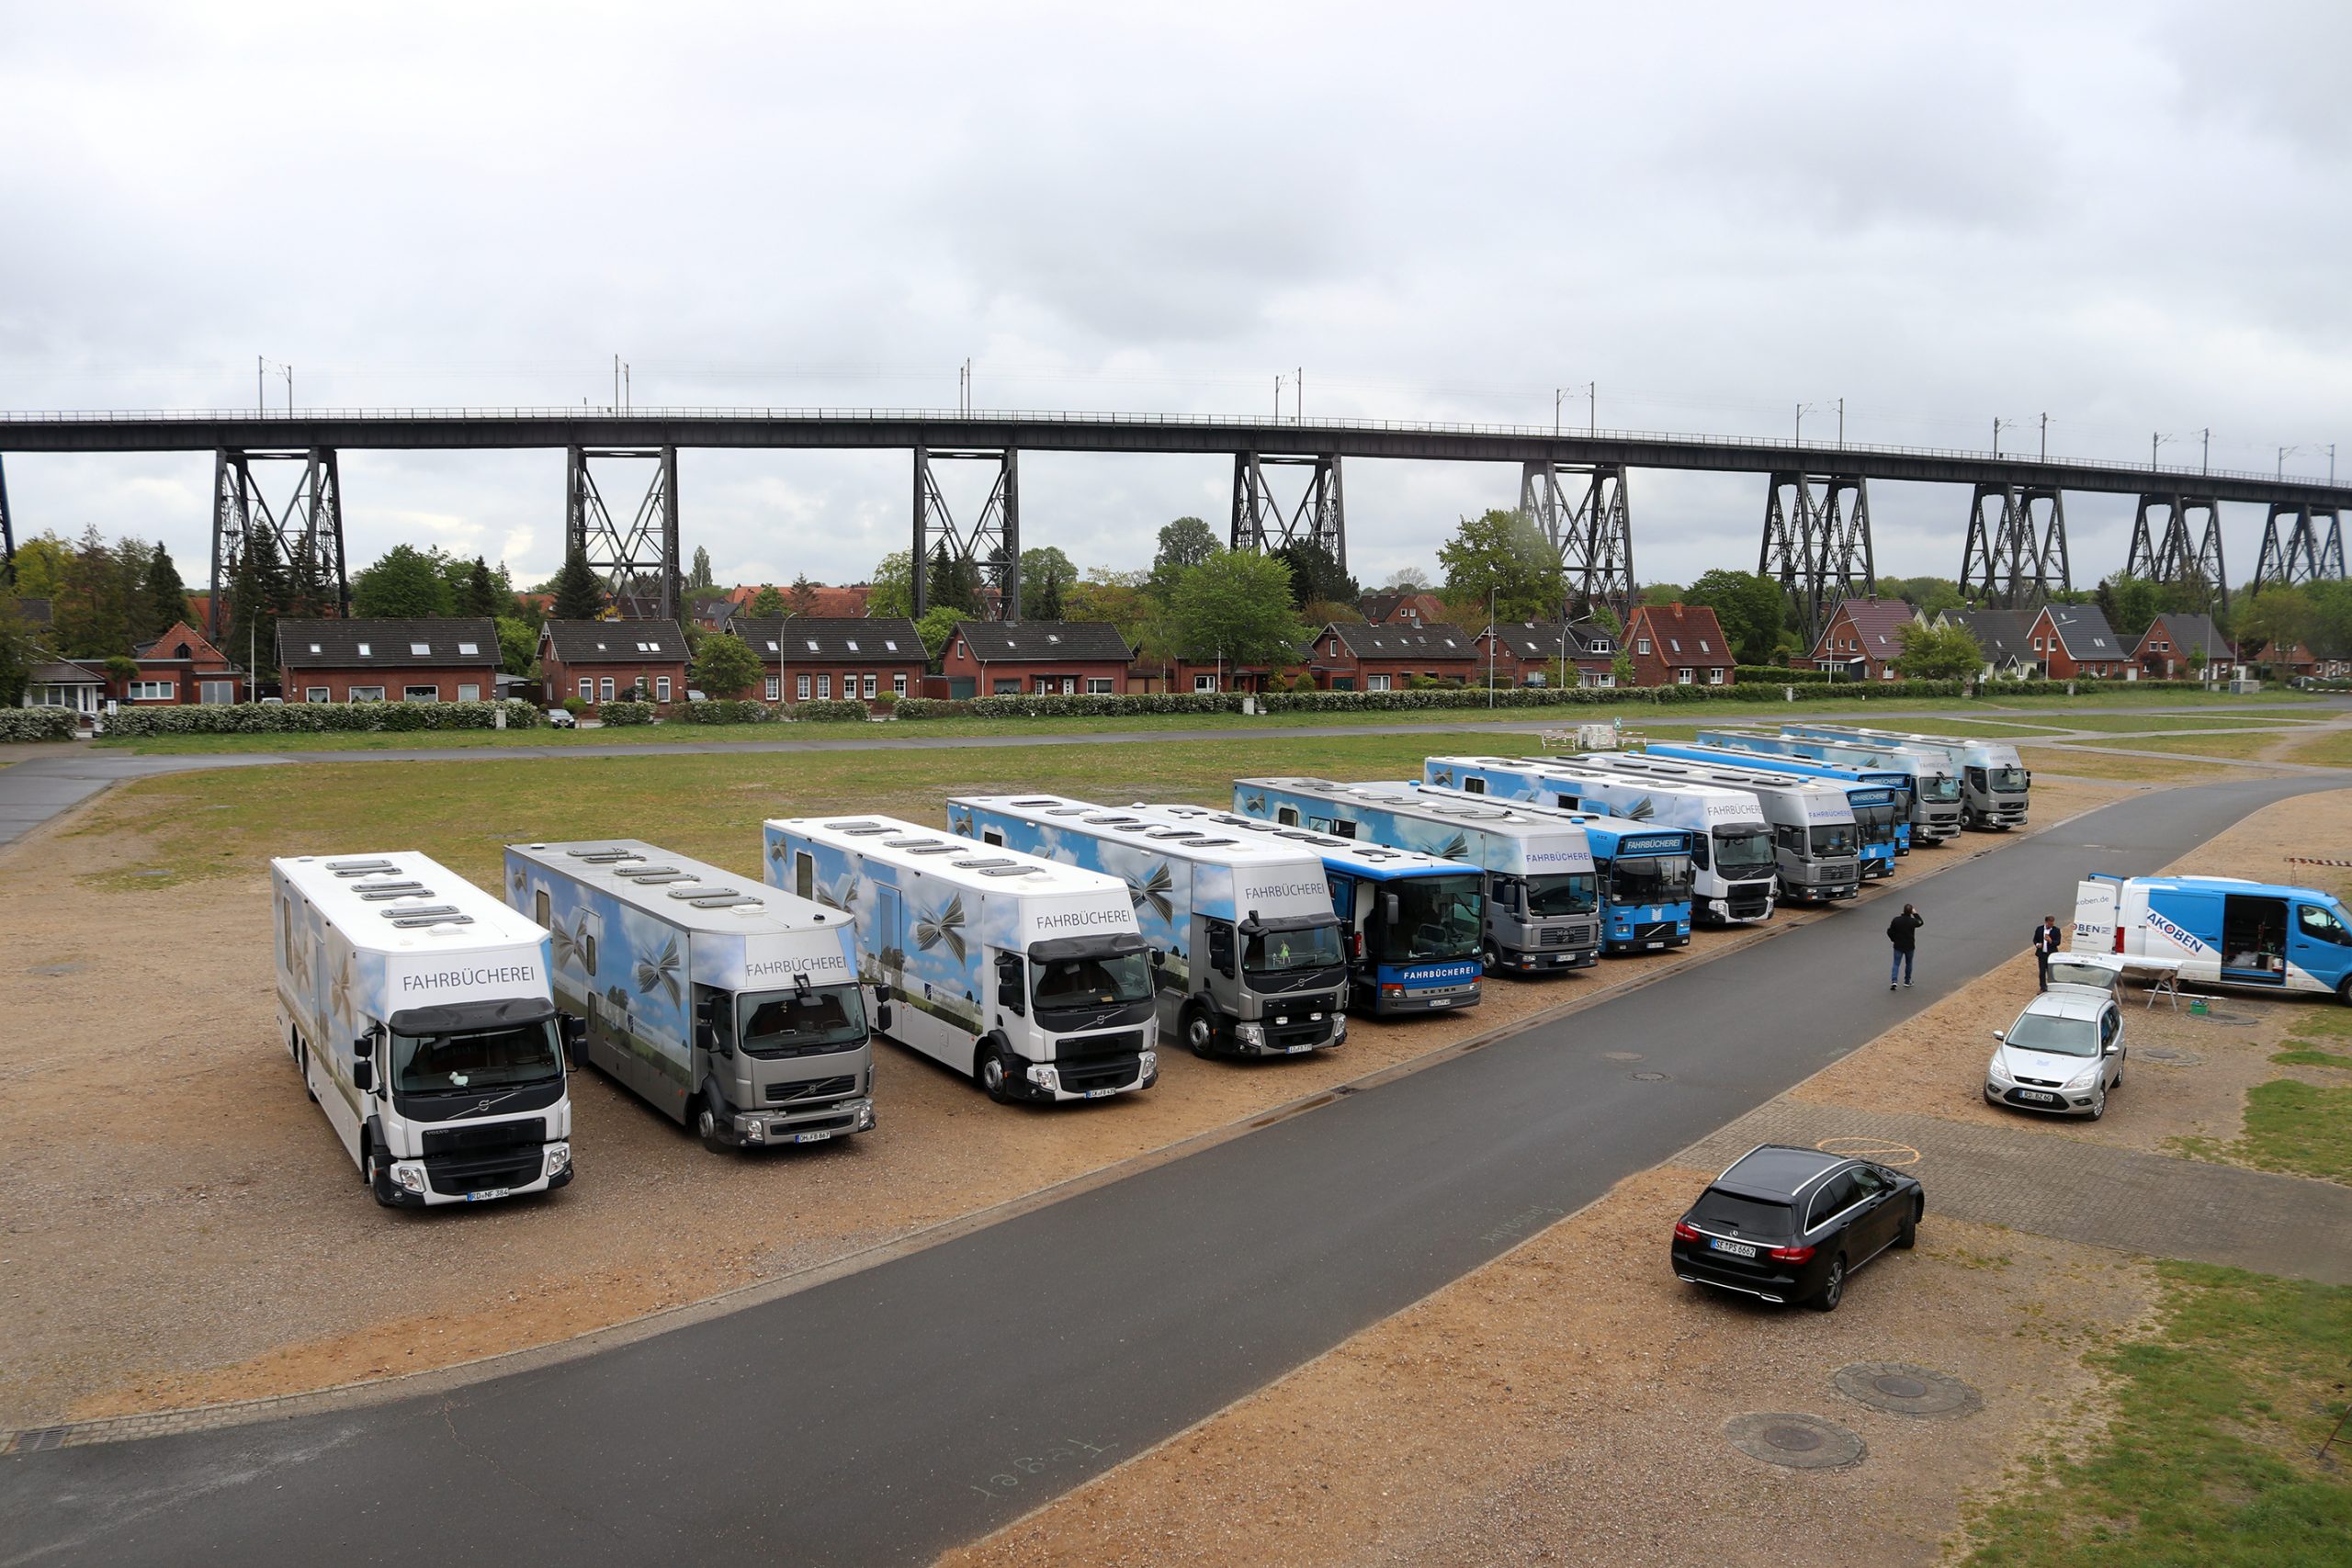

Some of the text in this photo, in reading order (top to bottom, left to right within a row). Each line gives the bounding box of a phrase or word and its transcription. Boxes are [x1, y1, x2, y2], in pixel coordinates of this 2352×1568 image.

[1707, 804, 1762, 817] FAHRBÜCHERE
[1627, 839, 1680, 850] FAHRBÜCHEREI
[1526, 852, 1591, 863] FAHRBÜCHEREI
[1246, 883, 1325, 899] FAHRBÜCHEREI
[1036, 910, 1131, 930] FAHRBÜCHEREI
[2147, 909, 2203, 953] AKOBEN
[746, 956, 847, 976] FAHRBÜCHEREI
[1404, 966, 1474, 979] FAHRBÜCHEREI
[403, 966, 535, 991] FAHRBÜCHEREI
[1715, 1240, 1755, 1256] SE PS 6662
